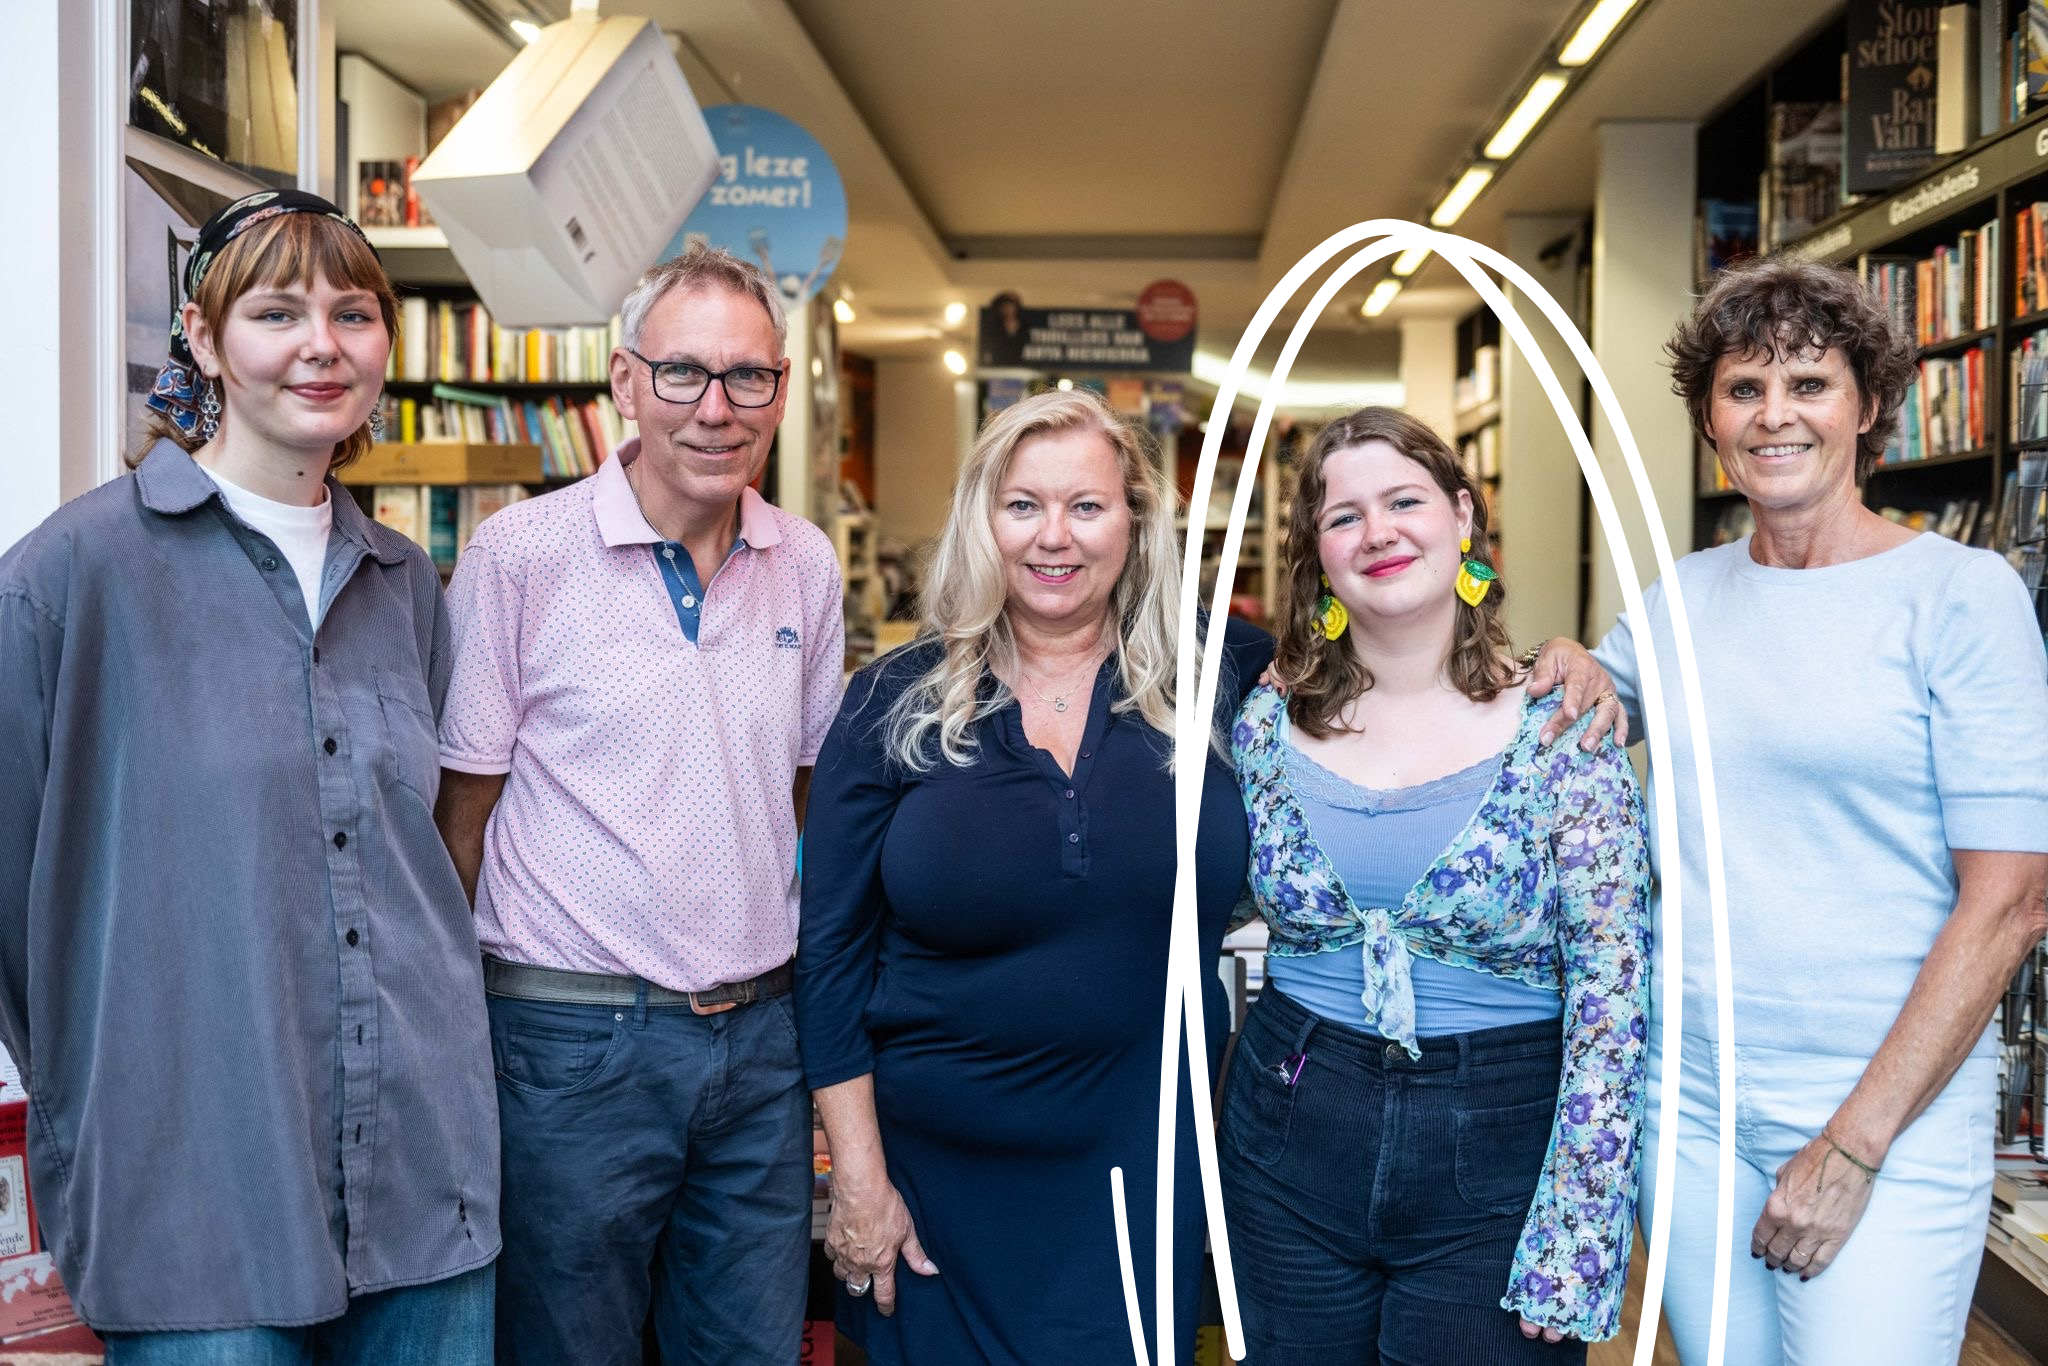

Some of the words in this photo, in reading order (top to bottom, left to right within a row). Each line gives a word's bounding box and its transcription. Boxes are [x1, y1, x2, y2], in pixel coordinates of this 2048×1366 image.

[1878, 0, 1939, 36] Stou
[1857, 27, 1939, 68] schoe
[745, 146, 808, 178] leze
[1888, 165, 1980, 226] Geschiedenis
